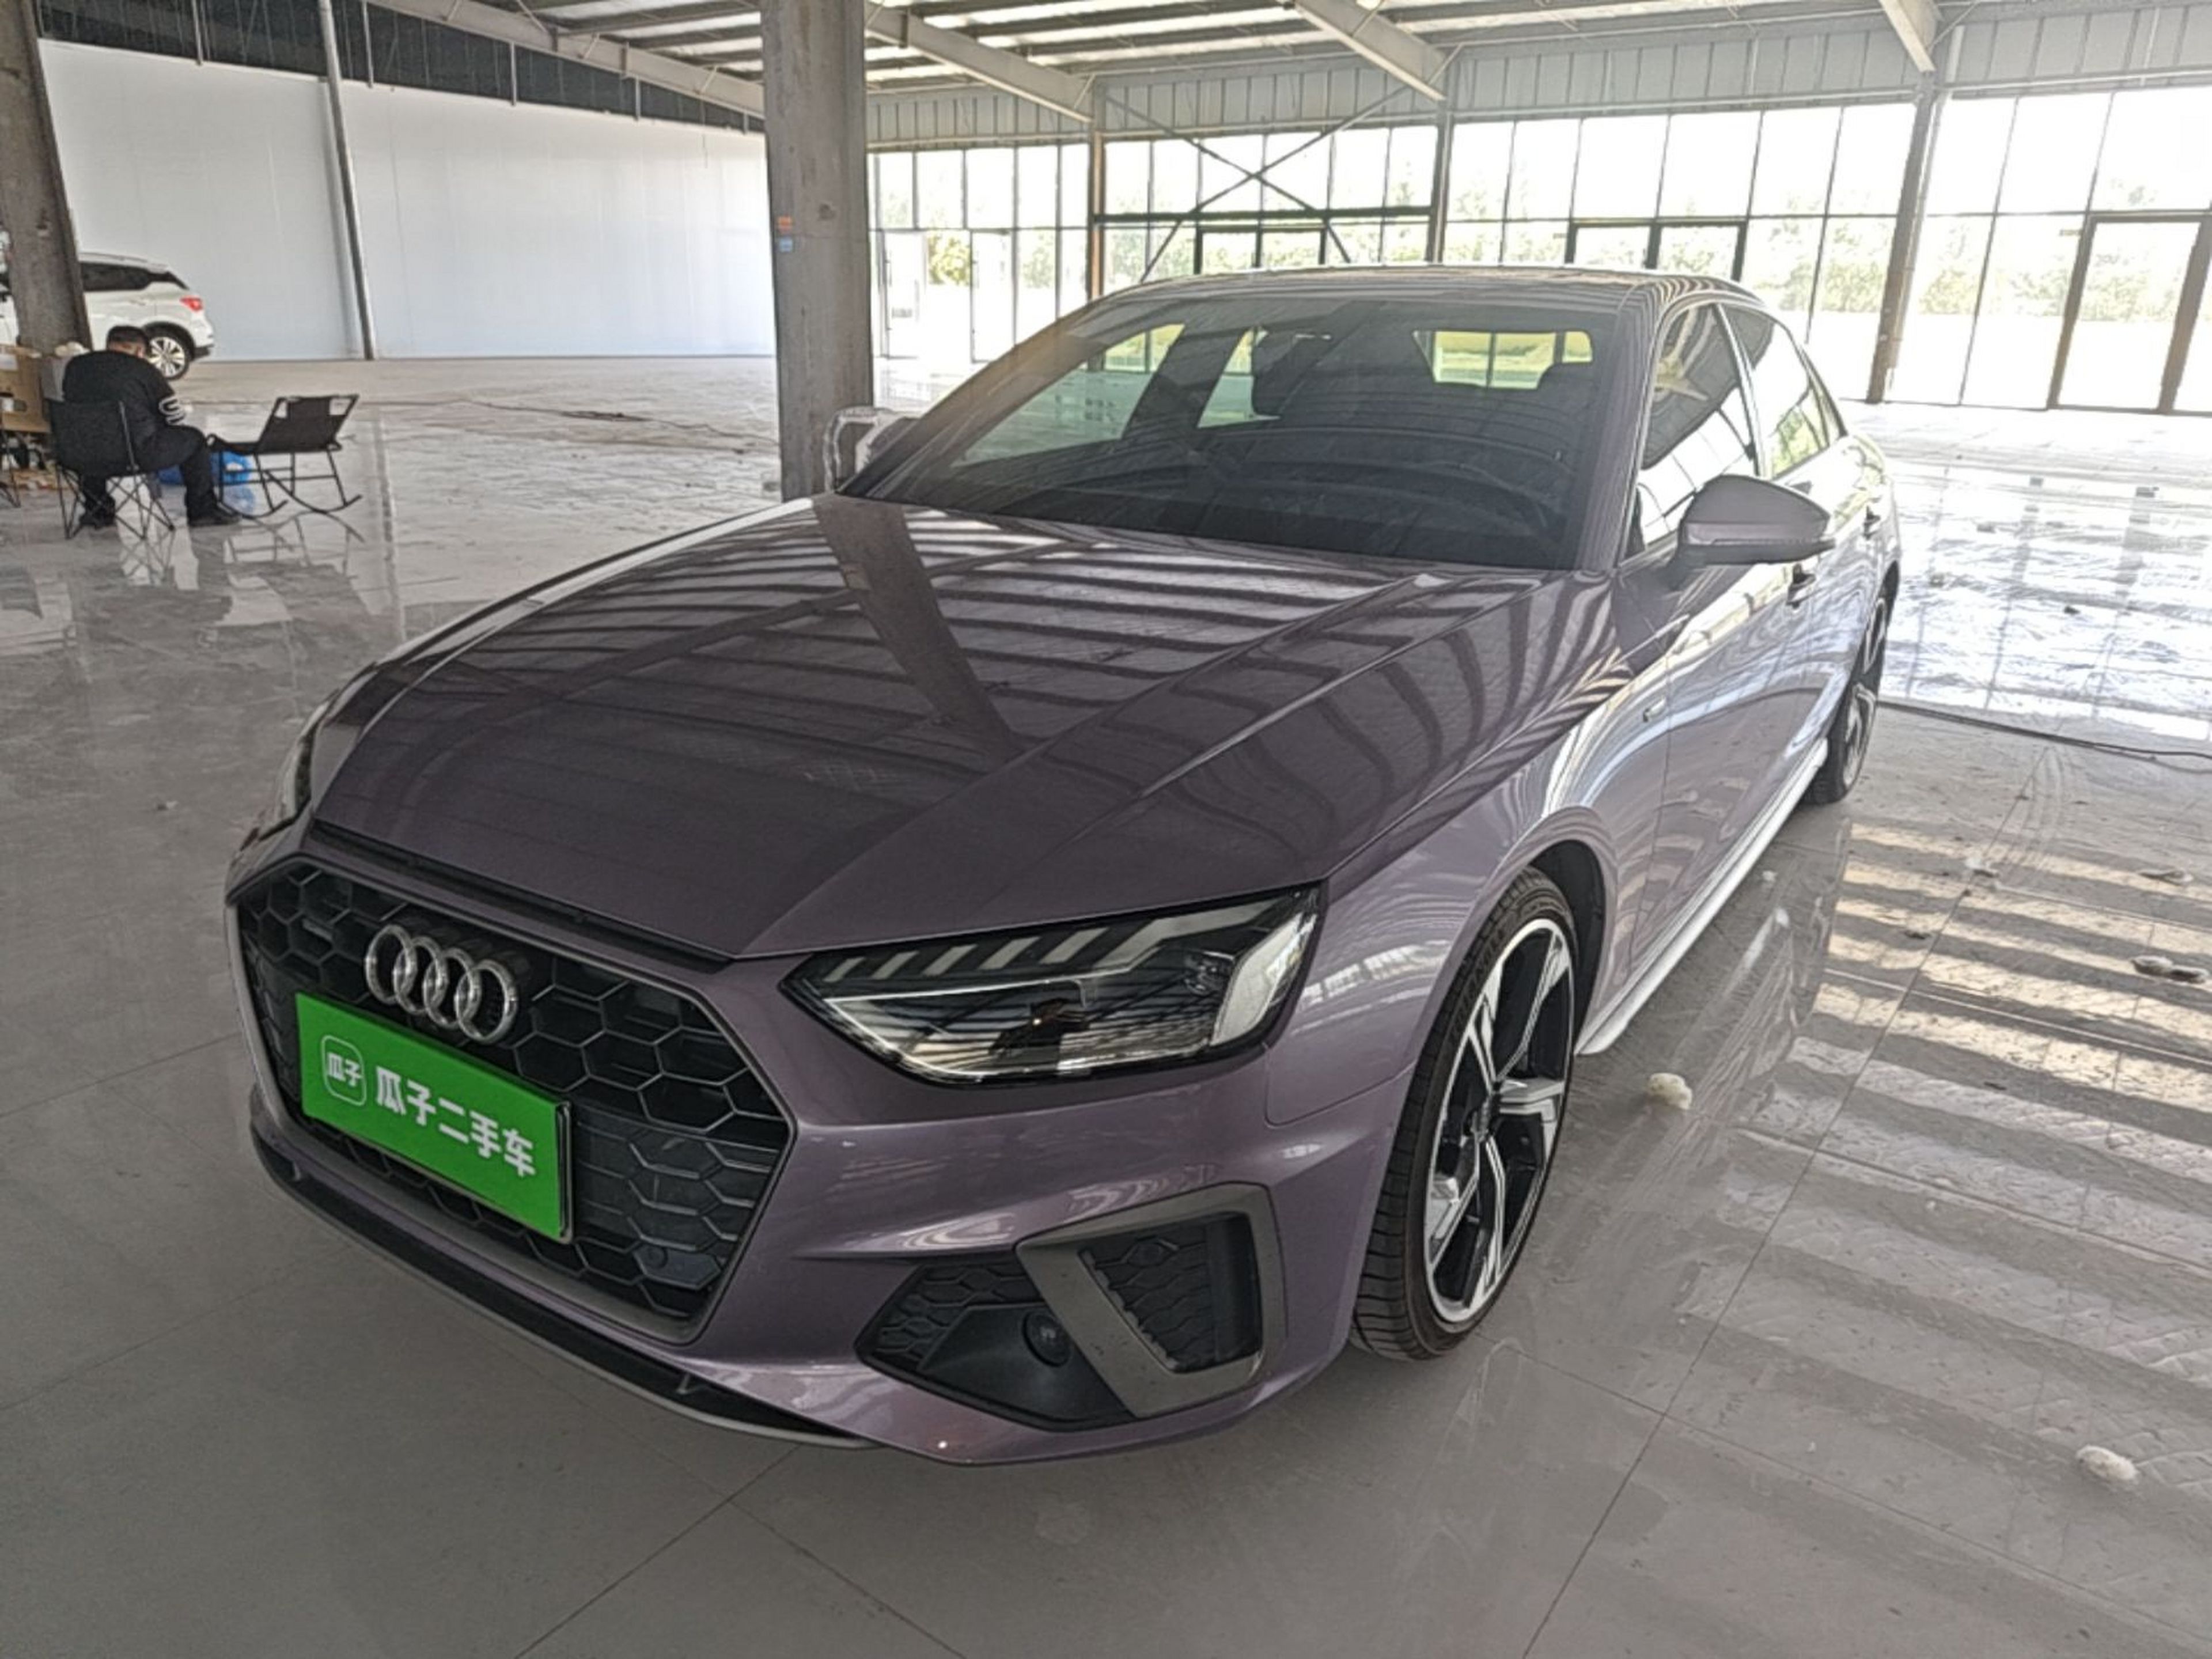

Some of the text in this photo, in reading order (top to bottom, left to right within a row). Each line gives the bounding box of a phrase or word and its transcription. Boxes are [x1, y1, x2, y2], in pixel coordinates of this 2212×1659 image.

[326, 1052, 362, 1087] 瓜子
[376, 1065, 536, 1177] 瓜子二手车
